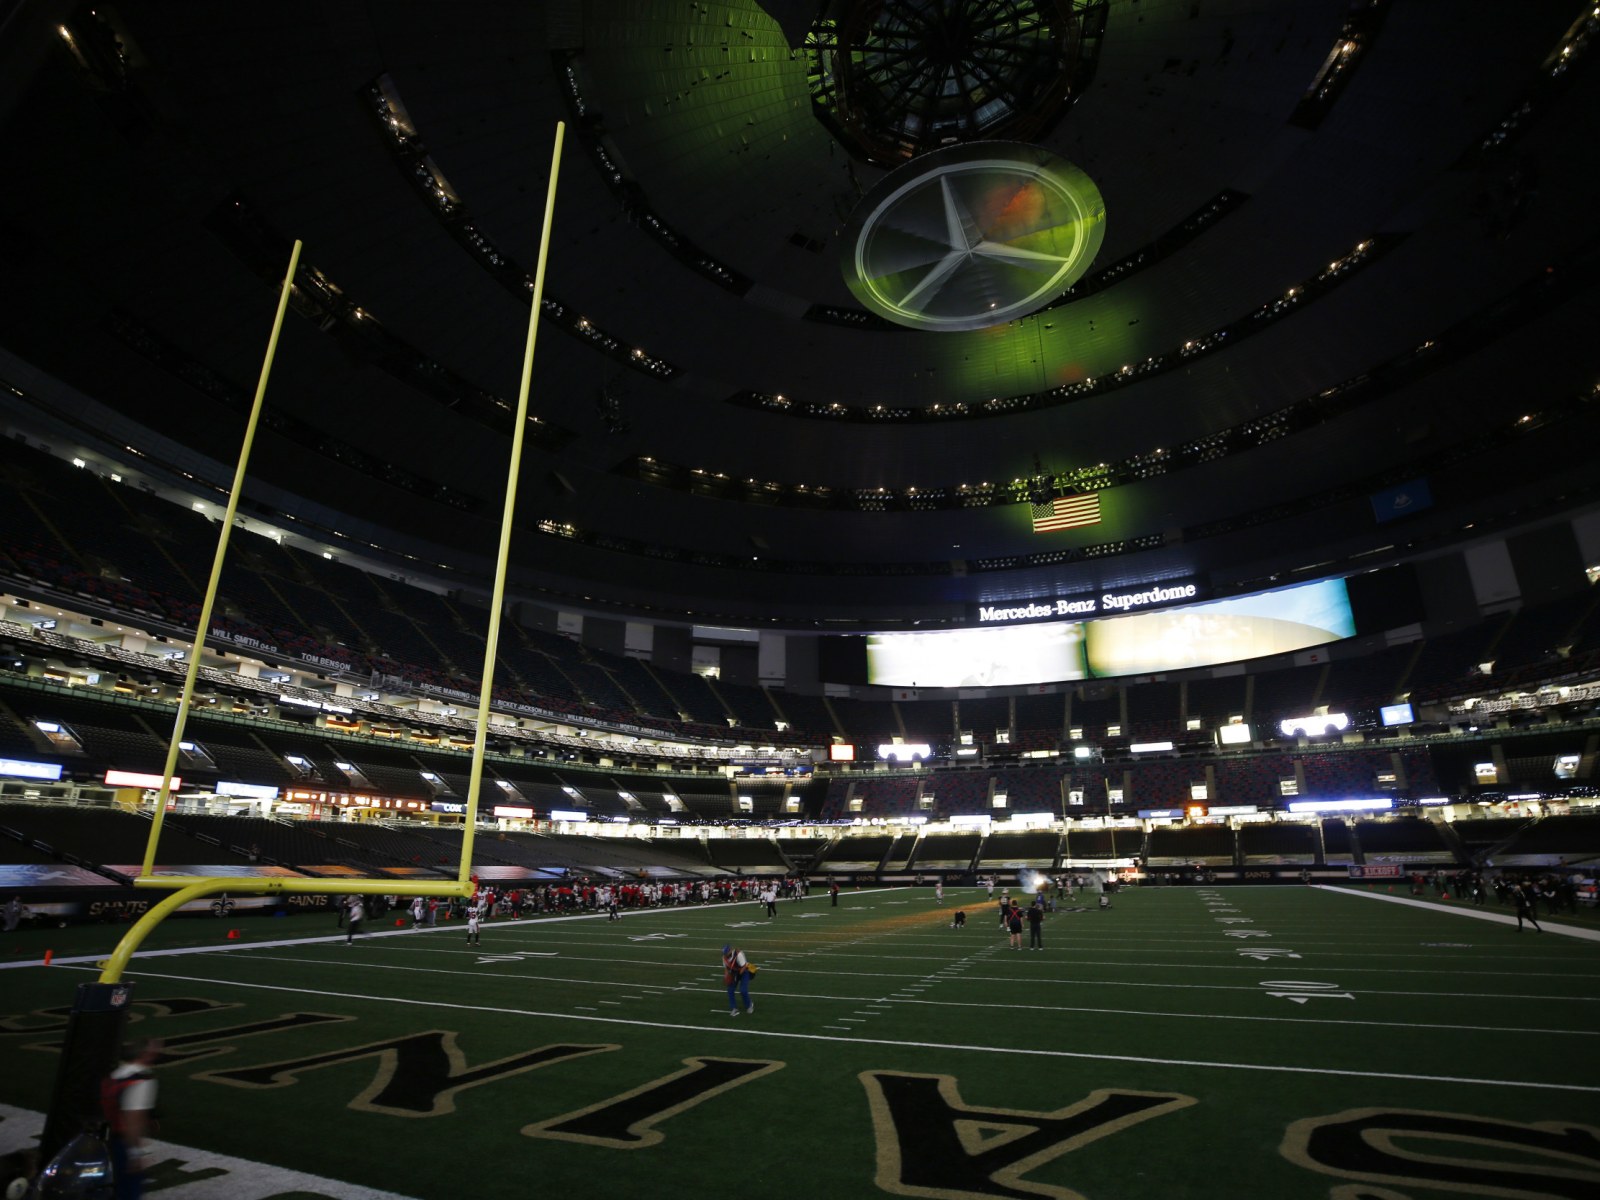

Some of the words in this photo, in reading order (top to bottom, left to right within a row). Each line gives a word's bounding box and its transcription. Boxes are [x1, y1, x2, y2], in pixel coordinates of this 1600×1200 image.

[979, 599, 1096, 621] Mercedes-Benz
[1102, 584, 1196, 610] Superdome
[212, 627, 231, 640] WILL
[233, 634, 259, 648] SMITH
[301, 652, 319, 663] TOM
[320, 656, 351, 671] BENSON
[420, 682, 442, 693] ARCHIE
[443, 687, 471, 700] MANNING
[497, 699, 517, 709] RICKEY
[517, 704, 543, 714] JACKSON
[1364, 866, 1397, 876] KICKOFF
[288, 895, 328, 906] SAINTS
